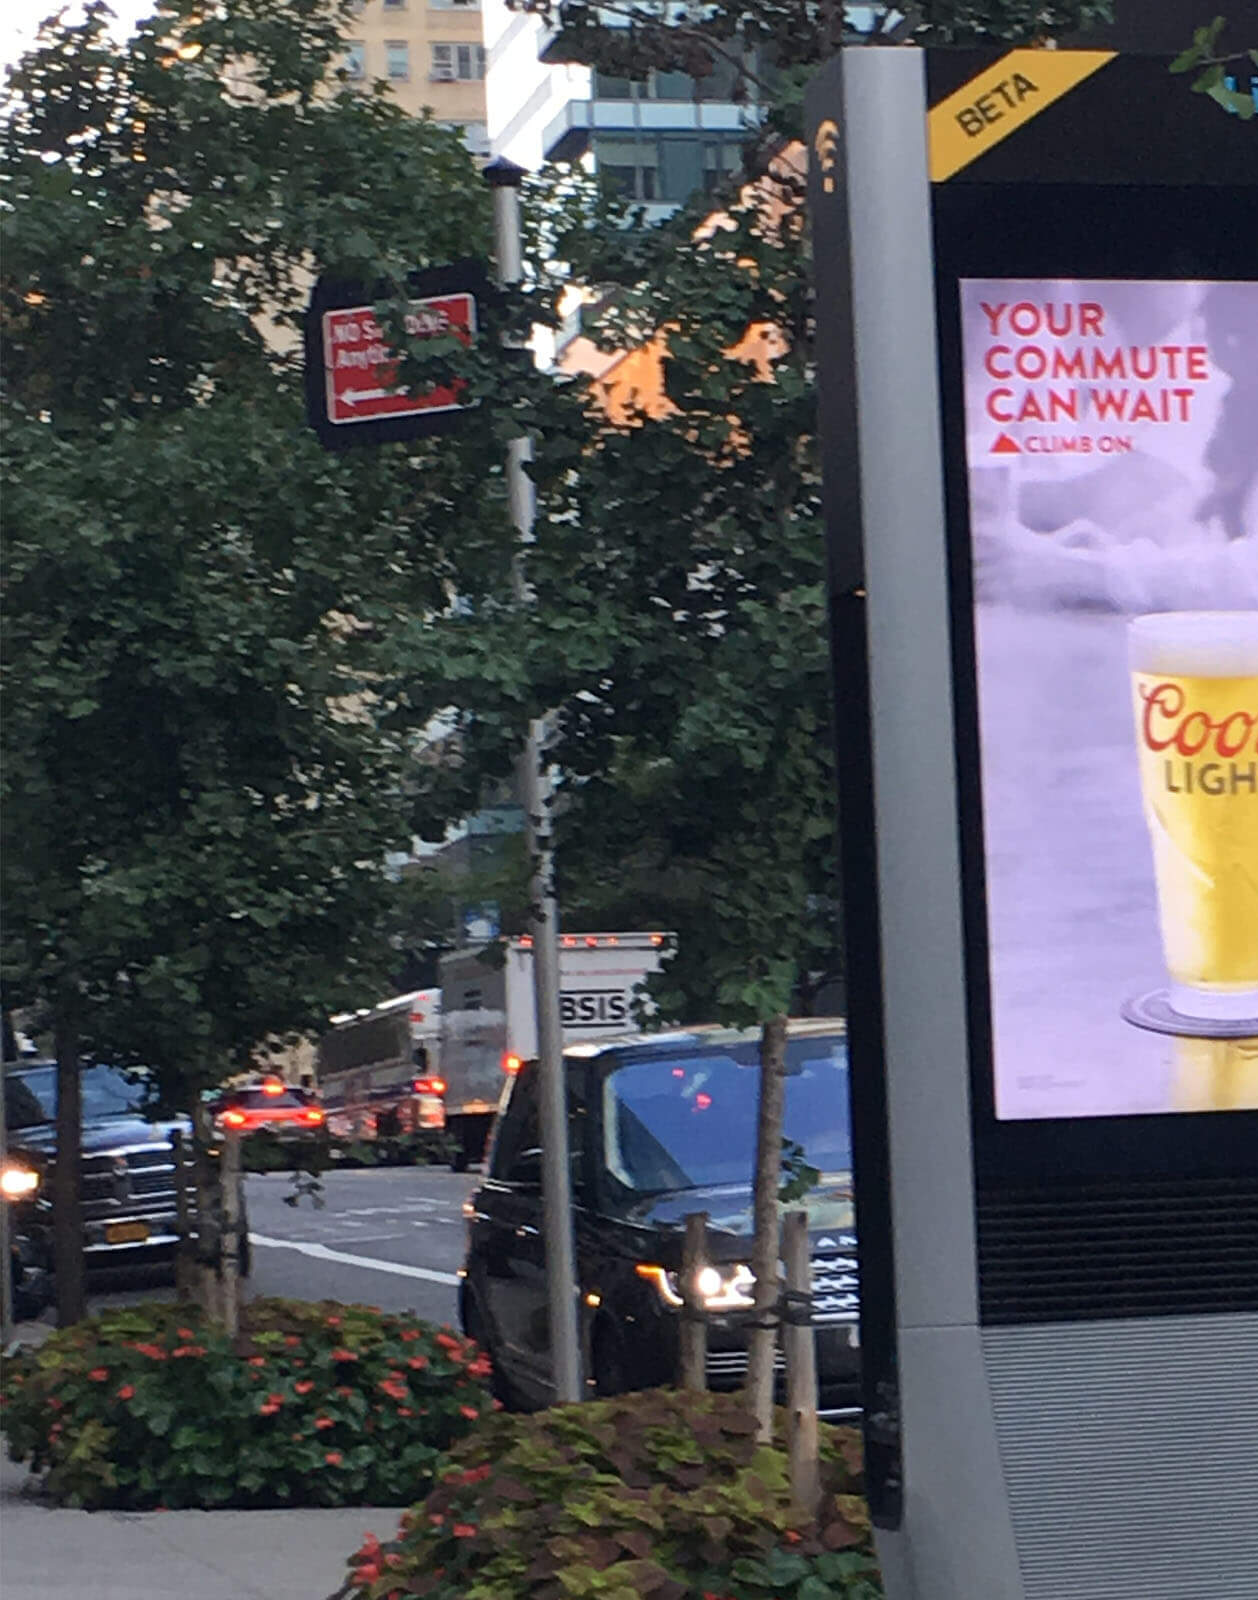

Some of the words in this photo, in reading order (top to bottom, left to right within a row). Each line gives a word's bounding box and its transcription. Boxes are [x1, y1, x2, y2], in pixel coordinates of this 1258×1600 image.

[955, 72, 1039, 137] BETA
[979, 300, 1106, 337] YOUR
[984, 345, 1208, 381] COMMUTE
[985, 388, 1078, 423] CAN
[1089, 388, 1195, 423] WAIT
[1024, 436, 1093, 454] CLIMB
[1099, 435, 1132, 454] ON
